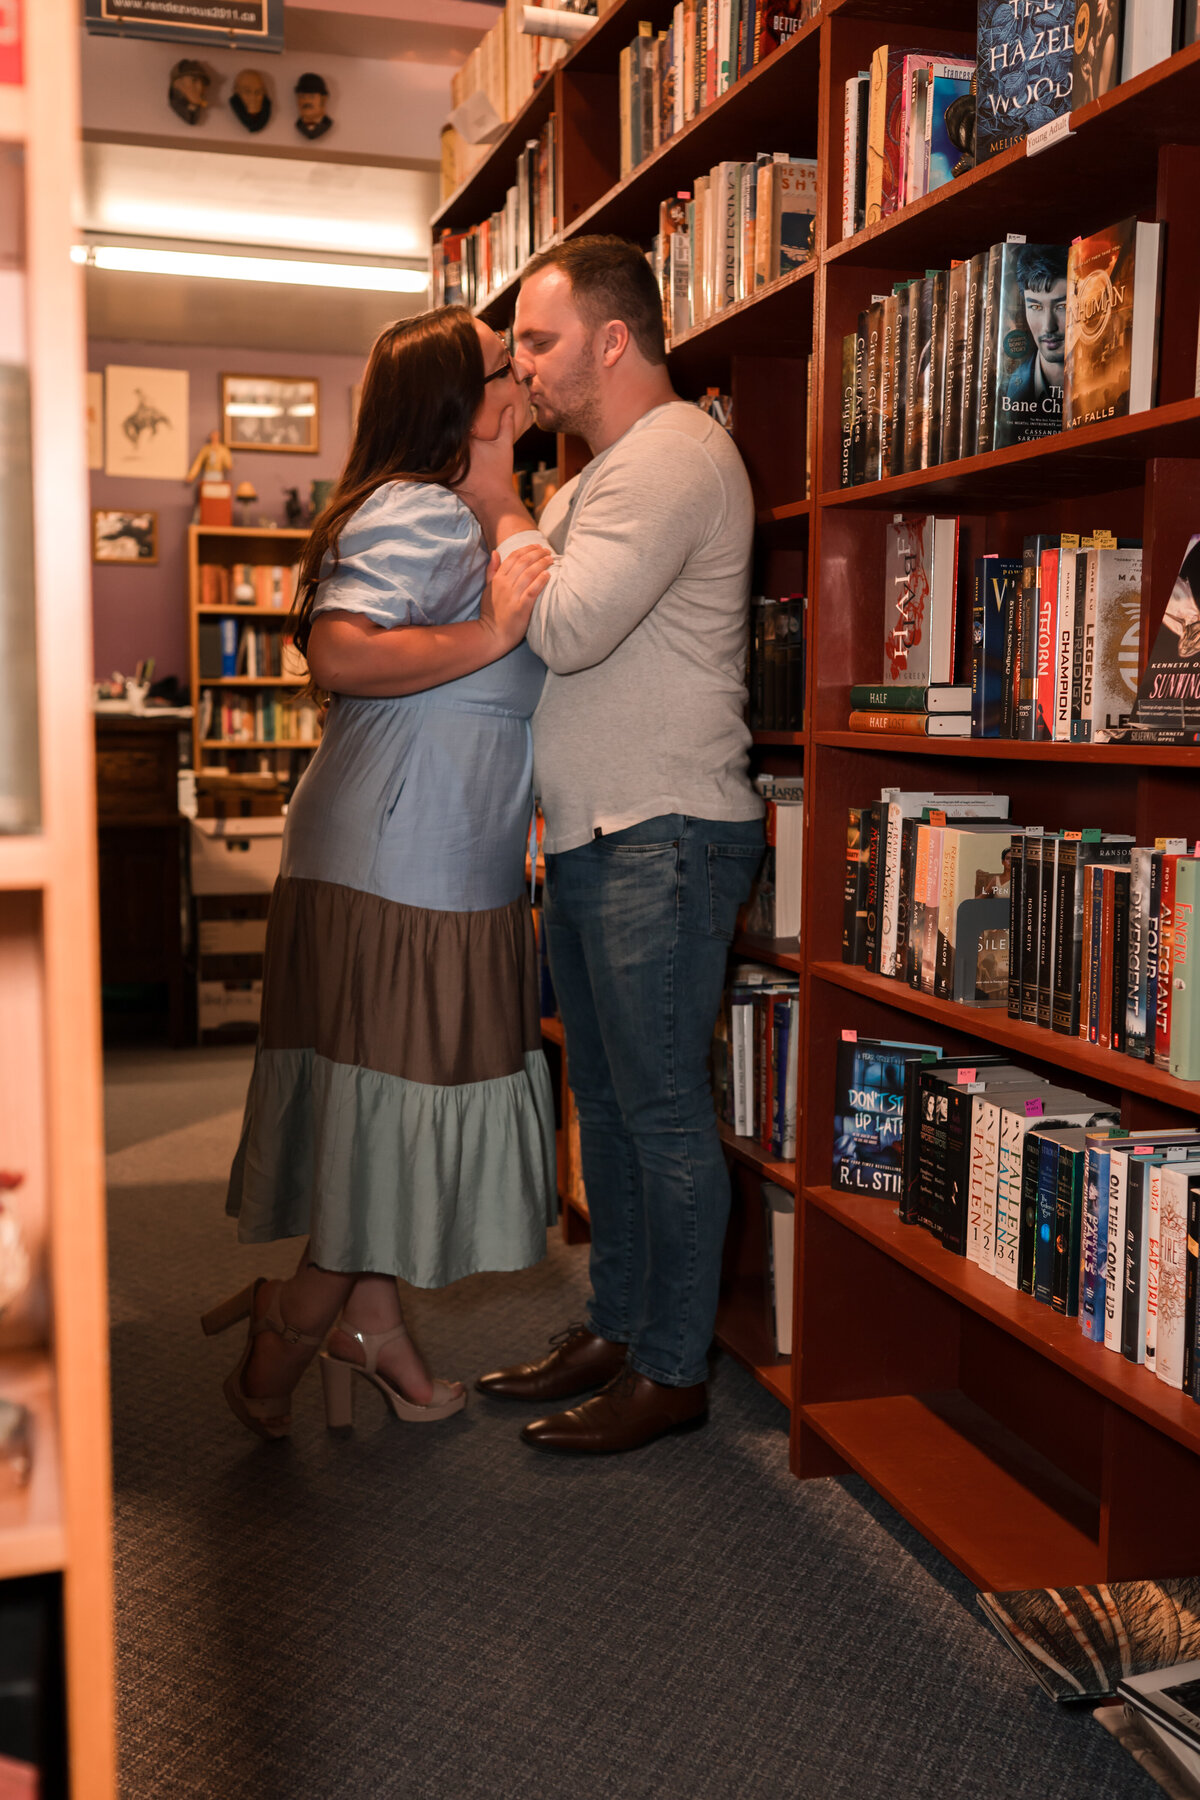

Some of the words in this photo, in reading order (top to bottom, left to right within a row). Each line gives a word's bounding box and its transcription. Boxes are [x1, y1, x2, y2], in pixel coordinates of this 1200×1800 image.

[989, 24, 1074, 72] HAZEL
[988, 72, 1074, 116] WOOD
[1026, 130, 1048, 148] Young
[1048, 118, 1068, 138] Adult
[929, 303, 938, 376] Clockwork
[947, 290, 958, 366] Clockwork
[966, 282, 977, 358] Clockwork
[984, 307, 993, 342] Bane
[856, 337, 865, 372] City
[868, 330, 878, 366] City
[843, 386, 852, 418] City
[882, 371, 891, 410] Fallen
[908, 354, 916, 420] Heavenly
[945, 370, 954, 427] Princess
[964, 364, 973, 409] Prince
[981, 346, 990, 425] Chronicles
[1001, 396, 1038, 413] Bane
[854, 394, 863, 443] Ashes
[867, 387, 876, 430] Glass
[892, 392, 900, 430] Souls
[1067, 416, 1082, 428] KAT
[1084, 406, 1115, 422] FALLS
[843, 438, 852, 484] Bones
[1038, 602, 1051, 676] THORN
[1059, 630, 1070, 721] CHAMPION
[1072, 625, 1083, 714] PRODIGY
[1084, 624, 1095, 706] LEGEND
[869, 693, 887, 703] HALF
[869, 718, 887, 727] HALF
[761, 785, 804, 799] HARRY
[886, 821, 894, 858] FREE
[891, 832, 899, 876] RADICAL
[868, 827, 878, 904] MAGICIANS
[949, 846, 957, 898] REQUIEM
[884, 865, 892, 916] MAGIC
[1042, 926, 1046, 936] OF
[1147, 917, 1158, 979] FOUR
[1128, 890, 1141, 1017] DIVERGENT
[1156, 902, 1171, 1033] ALLEGIANT
[848, 1089, 889, 1112] DON'T
[855, 1114, 872, 1131] UP
[840, 1166, 852, 1185] R.
[856, 1171, 868, 1188] L.
[970, 1132, 984, 1227] FALLEN
[983, 1139, 996, 1236] FALLEN
[997, 1146, 1009, 1244] FALLEN
[1109, 1174, 1119, 1197] ON
[1151, 1177, 1160, 1213] VOIGT
[1007, 1151, 1021, 1250] FALLEN
[1108, 1205, 1118, 1236] THE
[973, 1227, 978, 1241] 1
[983, 1236, 990, 1250] 2
[997, 1244, 1004, 1259] 3
[1083, 1212, 1095, 1275] FALLS
[1148, 1237, 1159, 1265] BAD
[1008, 1249, 1016, 1264] 4
[1105, 1241, 1117, 1292] COME
[1105, 1298, 1114, 1319] UP
[1147, 1268, 1158, 1316] GIRLS
